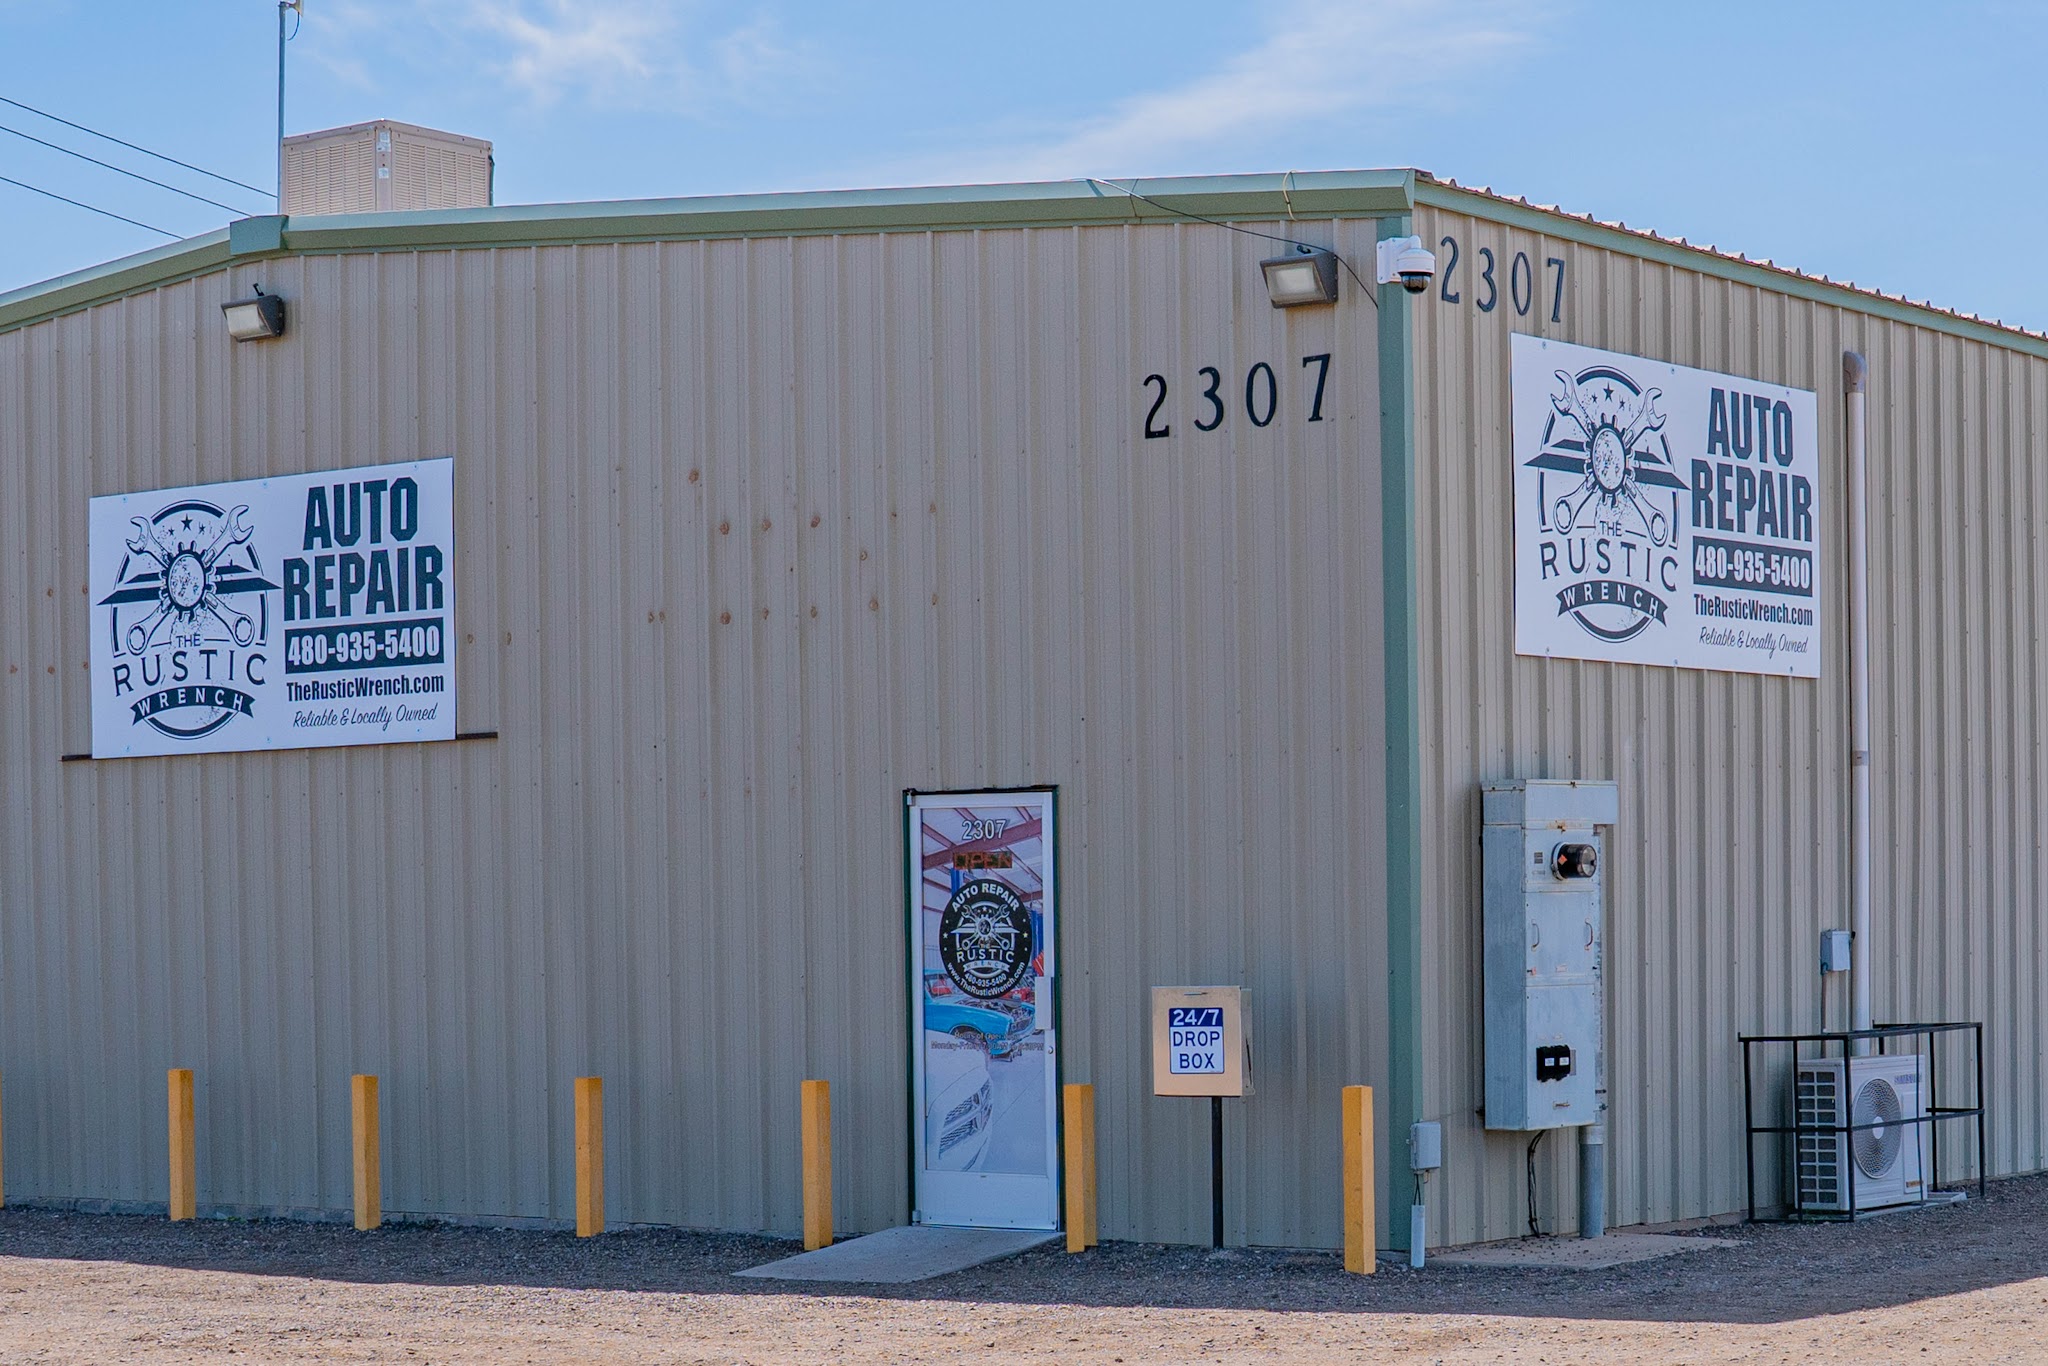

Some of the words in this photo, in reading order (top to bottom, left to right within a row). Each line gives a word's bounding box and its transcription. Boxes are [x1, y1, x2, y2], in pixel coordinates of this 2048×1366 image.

[1440, 236, 1566, 323] 2307
[1143, 353, 1331, 439] 2307
[1707, 387, 1793, 467] AUTO
[303, 477, 418, 551] AUTO
[1691, 458, 1812, 542] REPAIR
[1599, 521, 1622, 537] THE
[1539, 538, 1678, 593] RUSTIC
[1694, 545, 1811, 589] 480-935-5400
[283, 545, 444, 621] REPAIR
[1562, 581, 1659, 618] WRENCH
[1694, 593, 1813, 626] TheRusticWrench.com
[176, 634, 200, 648] THE
[287, 625, 440, 666] 480-935-5400
[1699, 626, 1735, 647] Reliable
[1737, 630, 1744, 648] &
[1746, 631, 1777, 660] Locally
[1779, 633, 1808, 653] Owned
[112, 650, 267, 697] RUSTIC
[286, 674, 444, 702] TheRusticWrench.com
[137, 687, 244, 717] WRENCH
[293, 708, 338, 727] Reliable
[340, 708, 349, 725] &
[351, 706, 391, 731] Locally
[396, 702, 438, 722] Owned
[962, 819, 1007, 840] 2307
[952, 885, 978, 912] AUTO
[981, 883, 1019, 911] REPAIR
[956, 949, 1014, 963] RUSTIC
[1173, 1009, 1219, 1026] 24/7
[1173, 1031, 1220, 1046] DROP
[1179, 1053, 1215, 1068] BOX
